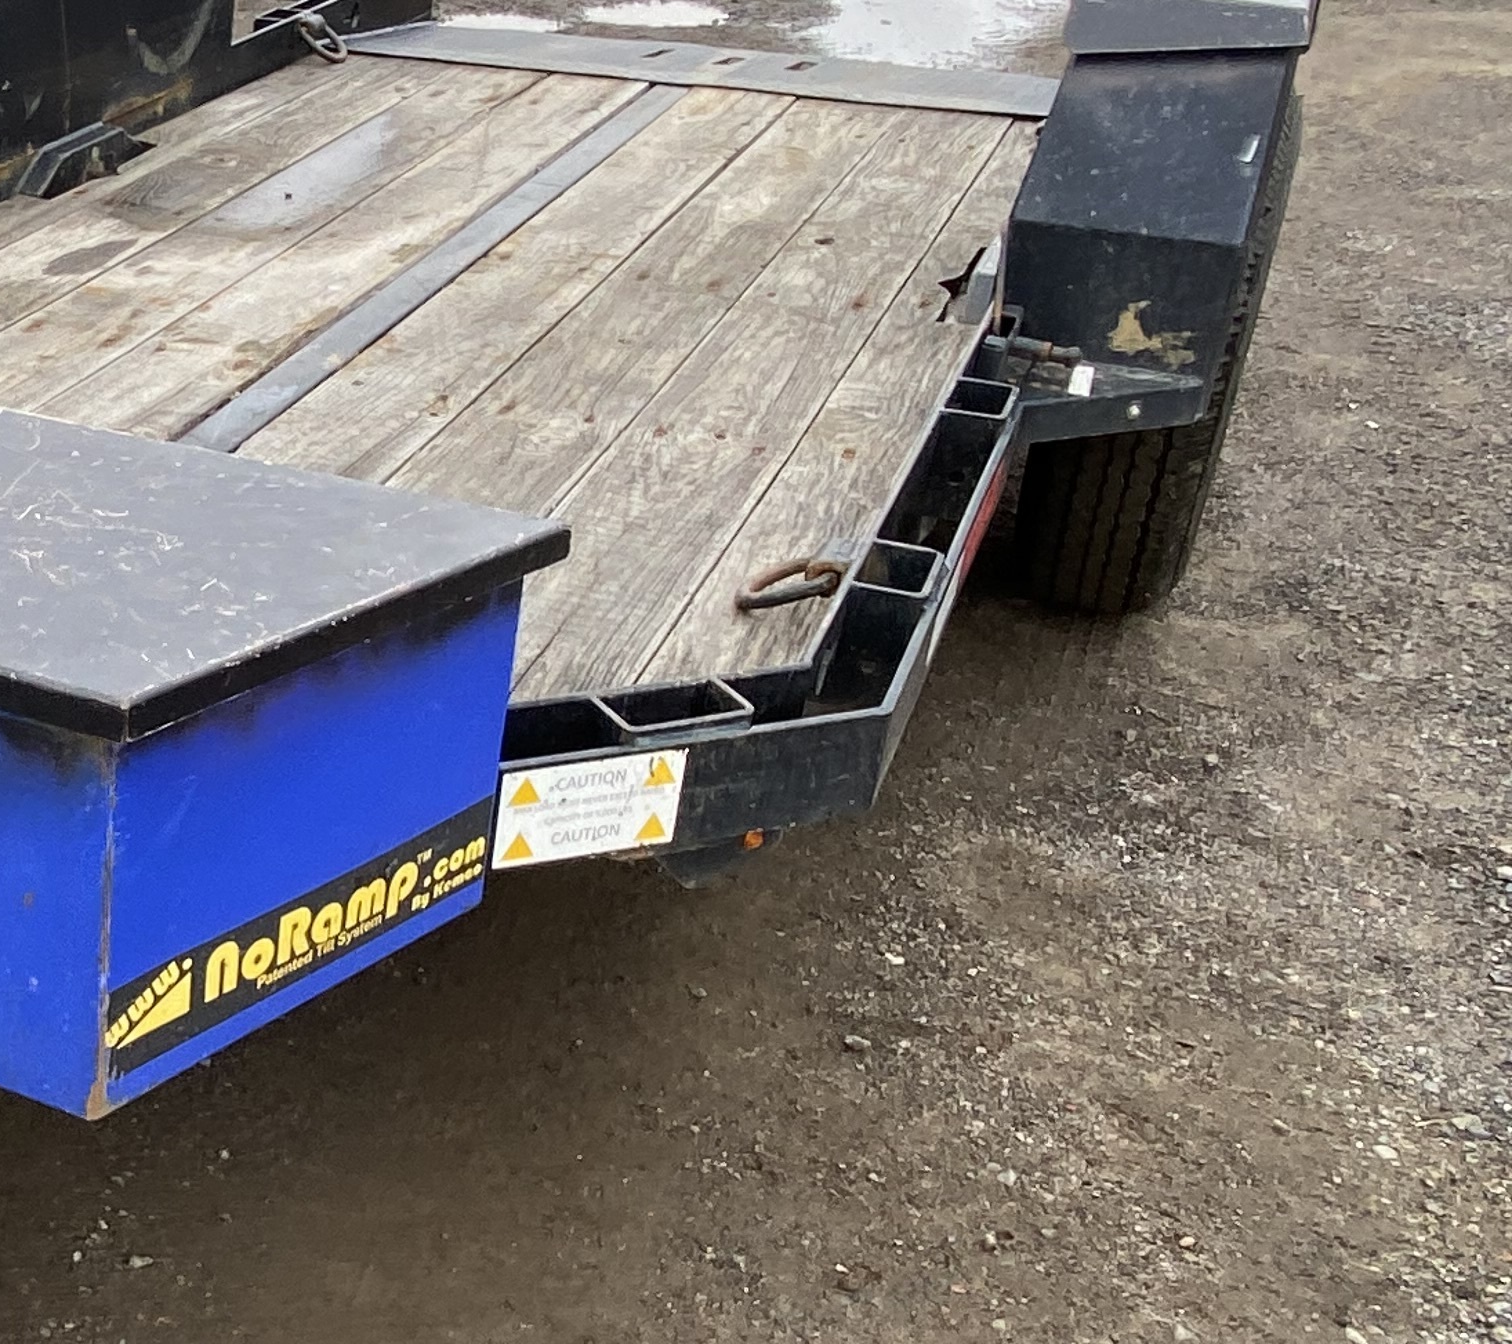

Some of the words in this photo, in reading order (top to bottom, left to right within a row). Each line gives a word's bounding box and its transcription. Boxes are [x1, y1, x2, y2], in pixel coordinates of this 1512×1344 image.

[556, 769, 628, 790] CAUTION
[551, 824, 621, 845] CAUTION
[411, 892, 430, 912] By
[256, 948, 313, 990] Patented
[316, 938, 335, 957] Tilt
[337, 914, 382, 946] System
